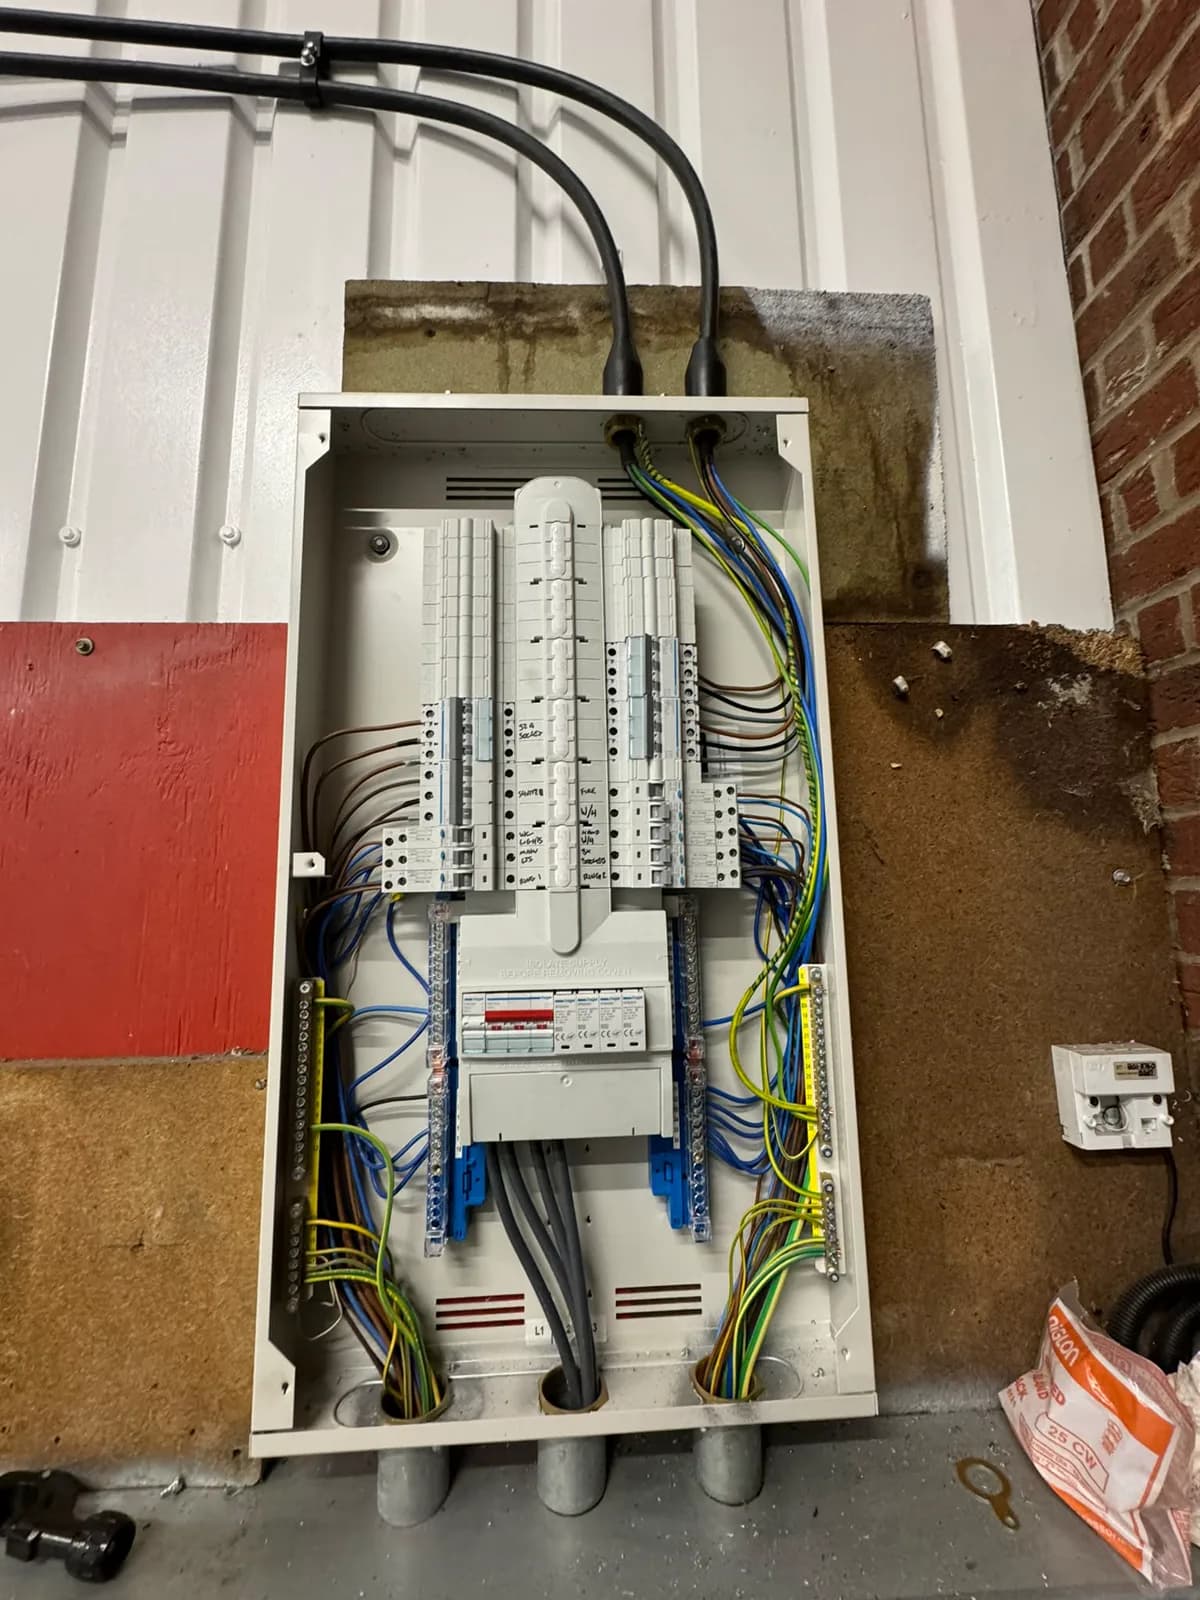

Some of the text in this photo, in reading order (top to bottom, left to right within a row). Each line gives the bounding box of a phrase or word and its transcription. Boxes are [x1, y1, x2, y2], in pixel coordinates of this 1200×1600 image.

[535, 1326, 544, 1336] L1
[1047, 1425, 1067, 1444] 25
[1072, 1441, 1098, 1470] CW
